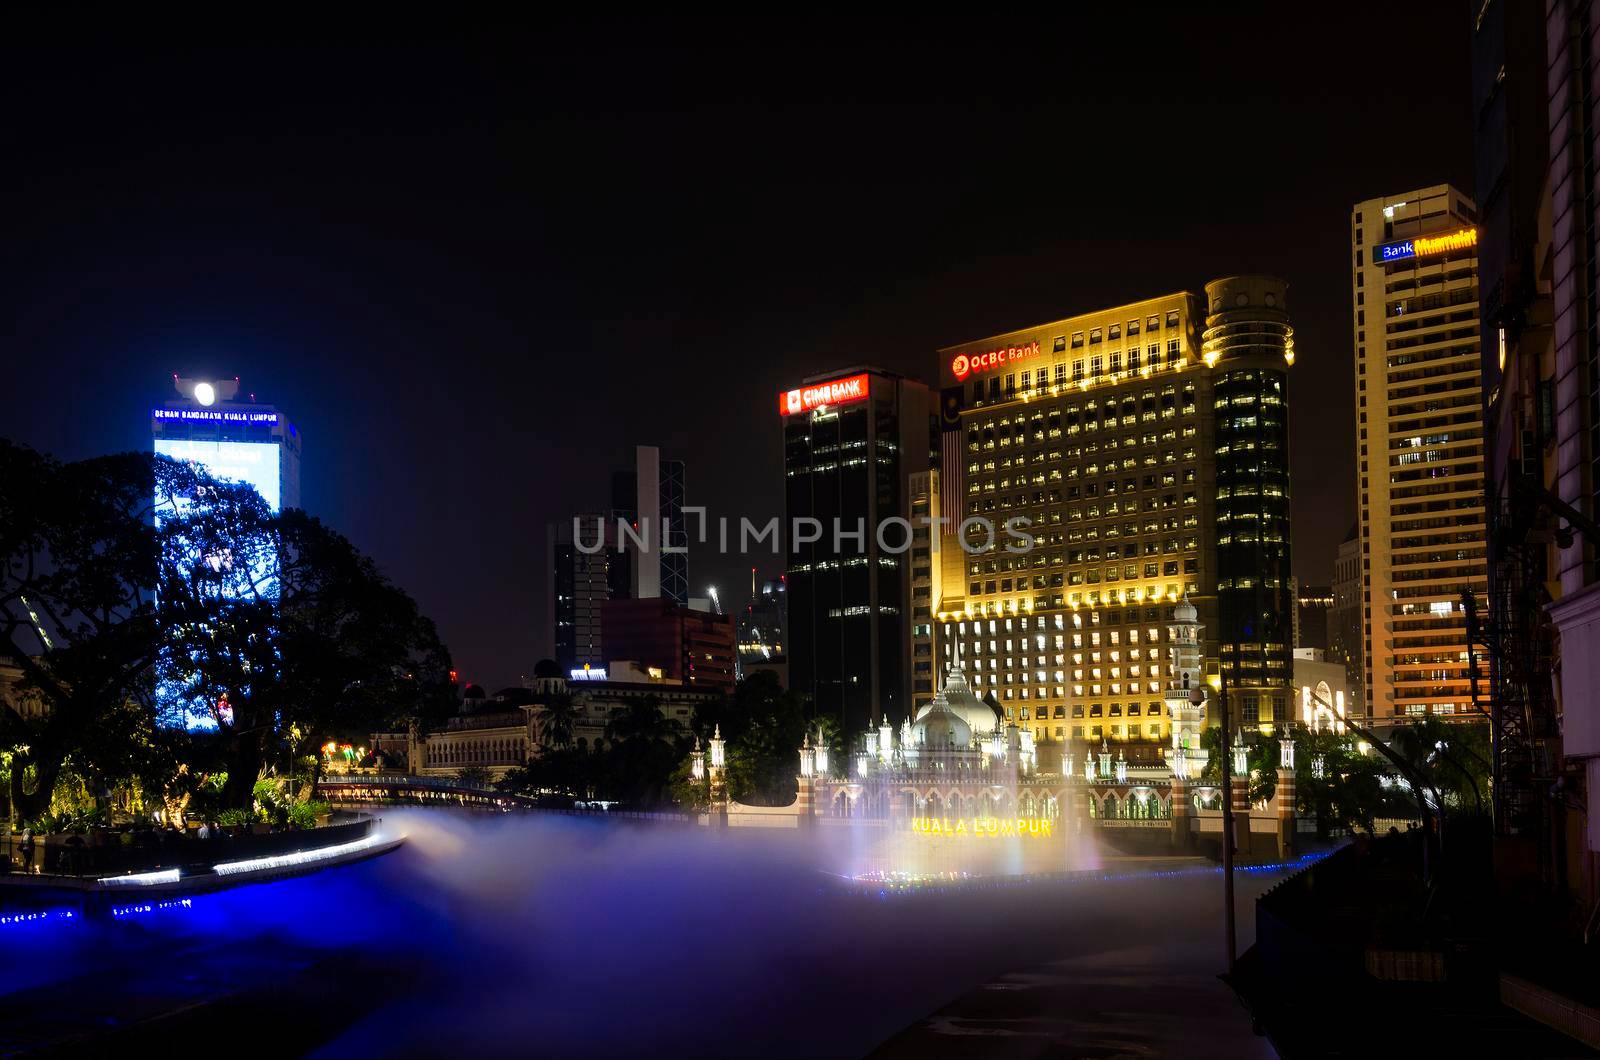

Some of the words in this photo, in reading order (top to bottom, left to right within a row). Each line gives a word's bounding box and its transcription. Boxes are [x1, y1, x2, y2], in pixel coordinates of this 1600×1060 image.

[1384, 242, 1414, 257] Bank
[971, 350, 1005, 368] OCBC
[1009, 342, 1040, 360] Bank
[803, 386, 831, 407] CIMB
[832, 380, 860, 401] BANK
[154, 410, 180, 418] DEWAN
[182, 411, 222, 420] BANDARAYA
[225, 412, 247, 421] KUALA
[250, 414, 277, 422] LUMPUR
[912, 817, 967, 834] KUALA
[974, 817, 1051, 835] LUMPUR
